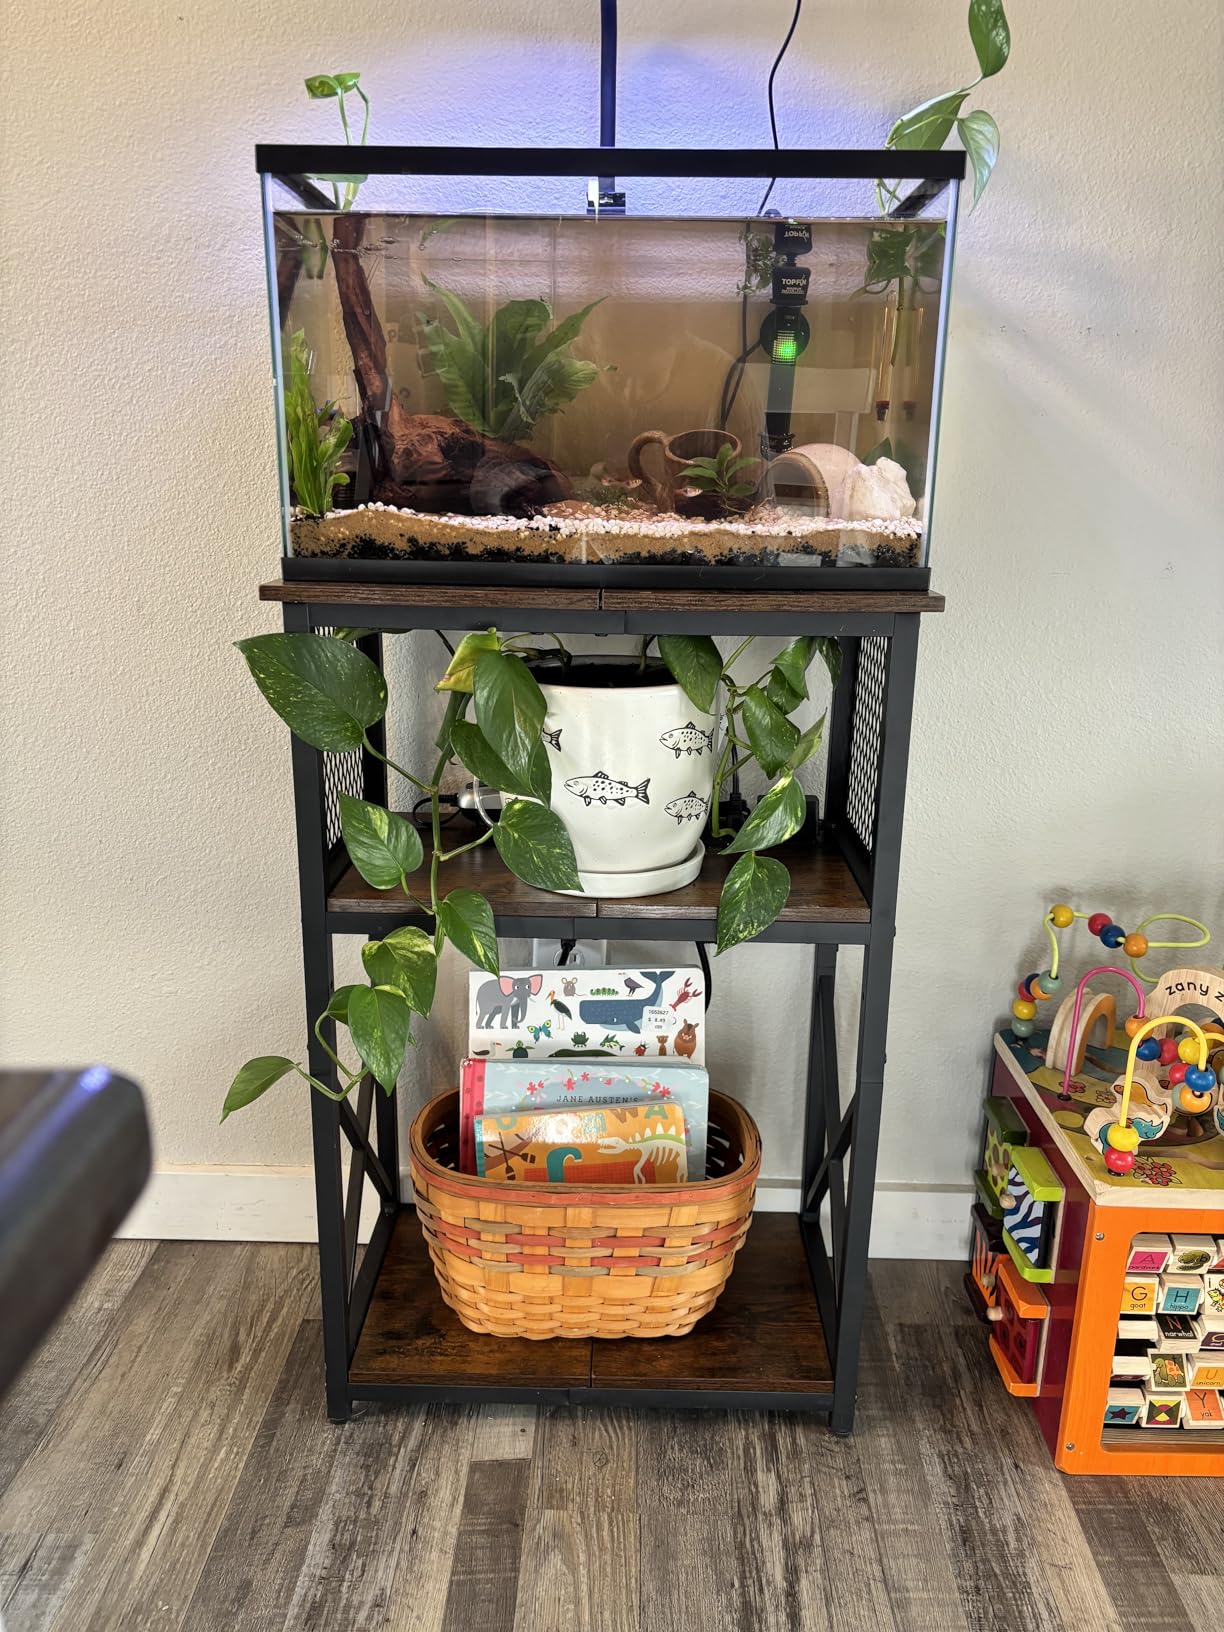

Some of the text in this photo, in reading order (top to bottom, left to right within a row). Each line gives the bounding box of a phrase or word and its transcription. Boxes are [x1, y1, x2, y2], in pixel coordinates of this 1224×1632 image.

[1165, 981, 1209, 996] zany
[557, 1095, 640, 1104] JANE AUSTEN'S
[1139, 1254, 1155, 1265] A
[1131, 1286, 1148, 1301] G
[1173, 1290, 1190, 1303] H
[1169, 1303, 1189, 1312] hippo
[1166, 1316, 1182, 1329] N
[1205, 1369, 1219, 1380] U
[1194, 1391, 1207, 1408] Y
[1200, 1410, 1214, 1420] yak
